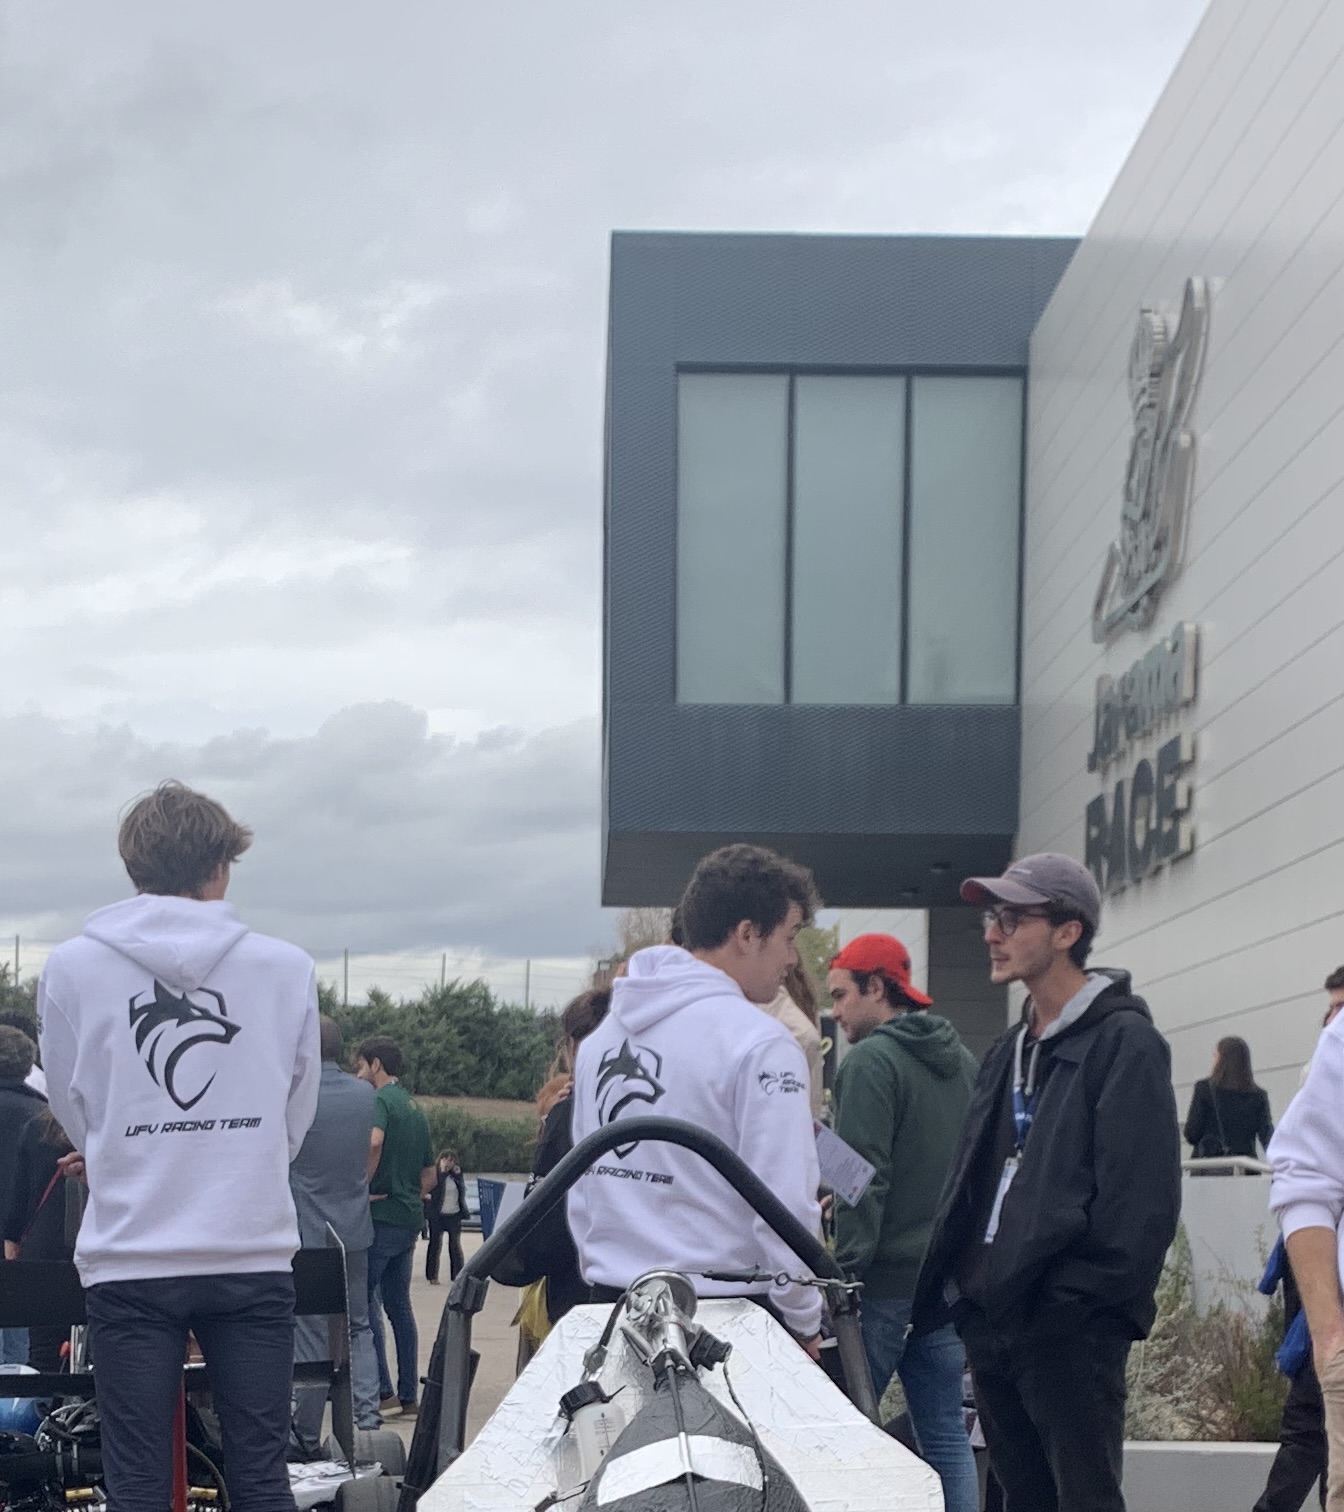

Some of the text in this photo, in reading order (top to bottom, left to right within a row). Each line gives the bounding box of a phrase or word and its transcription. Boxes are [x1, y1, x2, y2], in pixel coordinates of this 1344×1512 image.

[1085, 735, 1194, 893] RACE
[160, 1119, 217, 1134] RACING
[219, 1116, 263, 1131] TEAM
[596, 1165, 644, 1181] RACING
